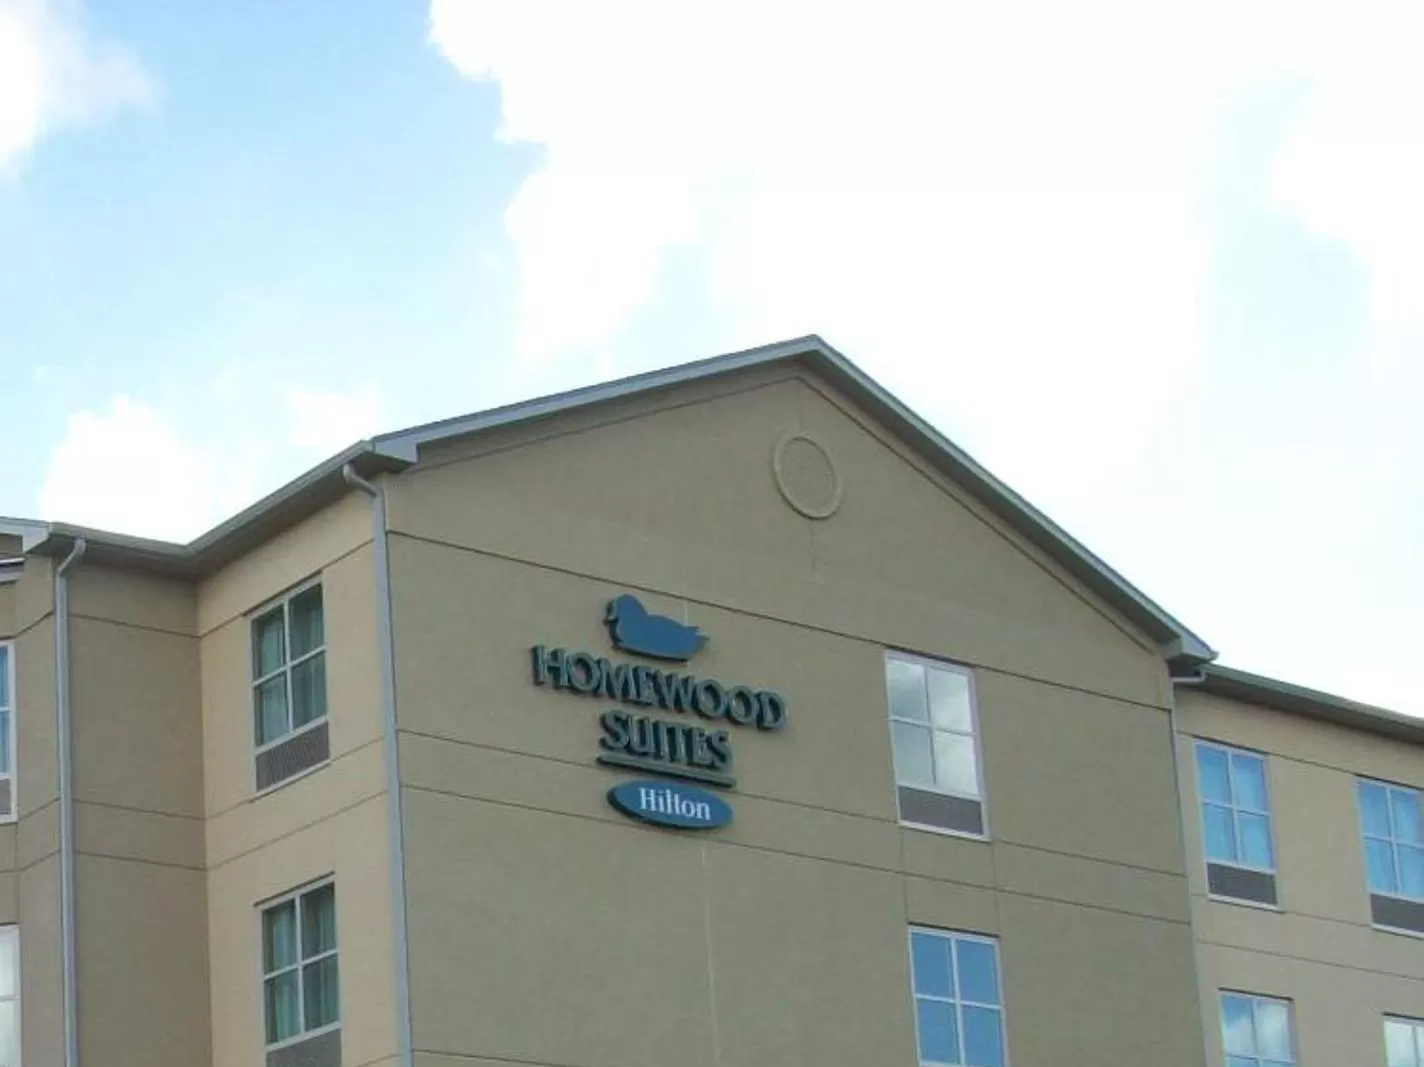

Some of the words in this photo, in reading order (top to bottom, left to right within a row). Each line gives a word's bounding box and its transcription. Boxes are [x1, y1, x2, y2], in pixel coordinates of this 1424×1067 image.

[531, 644, 788, 730] HOMEWOOD
[599, 709, 733, 769] SUITES
[638, 786, 711, 821] Hilton
